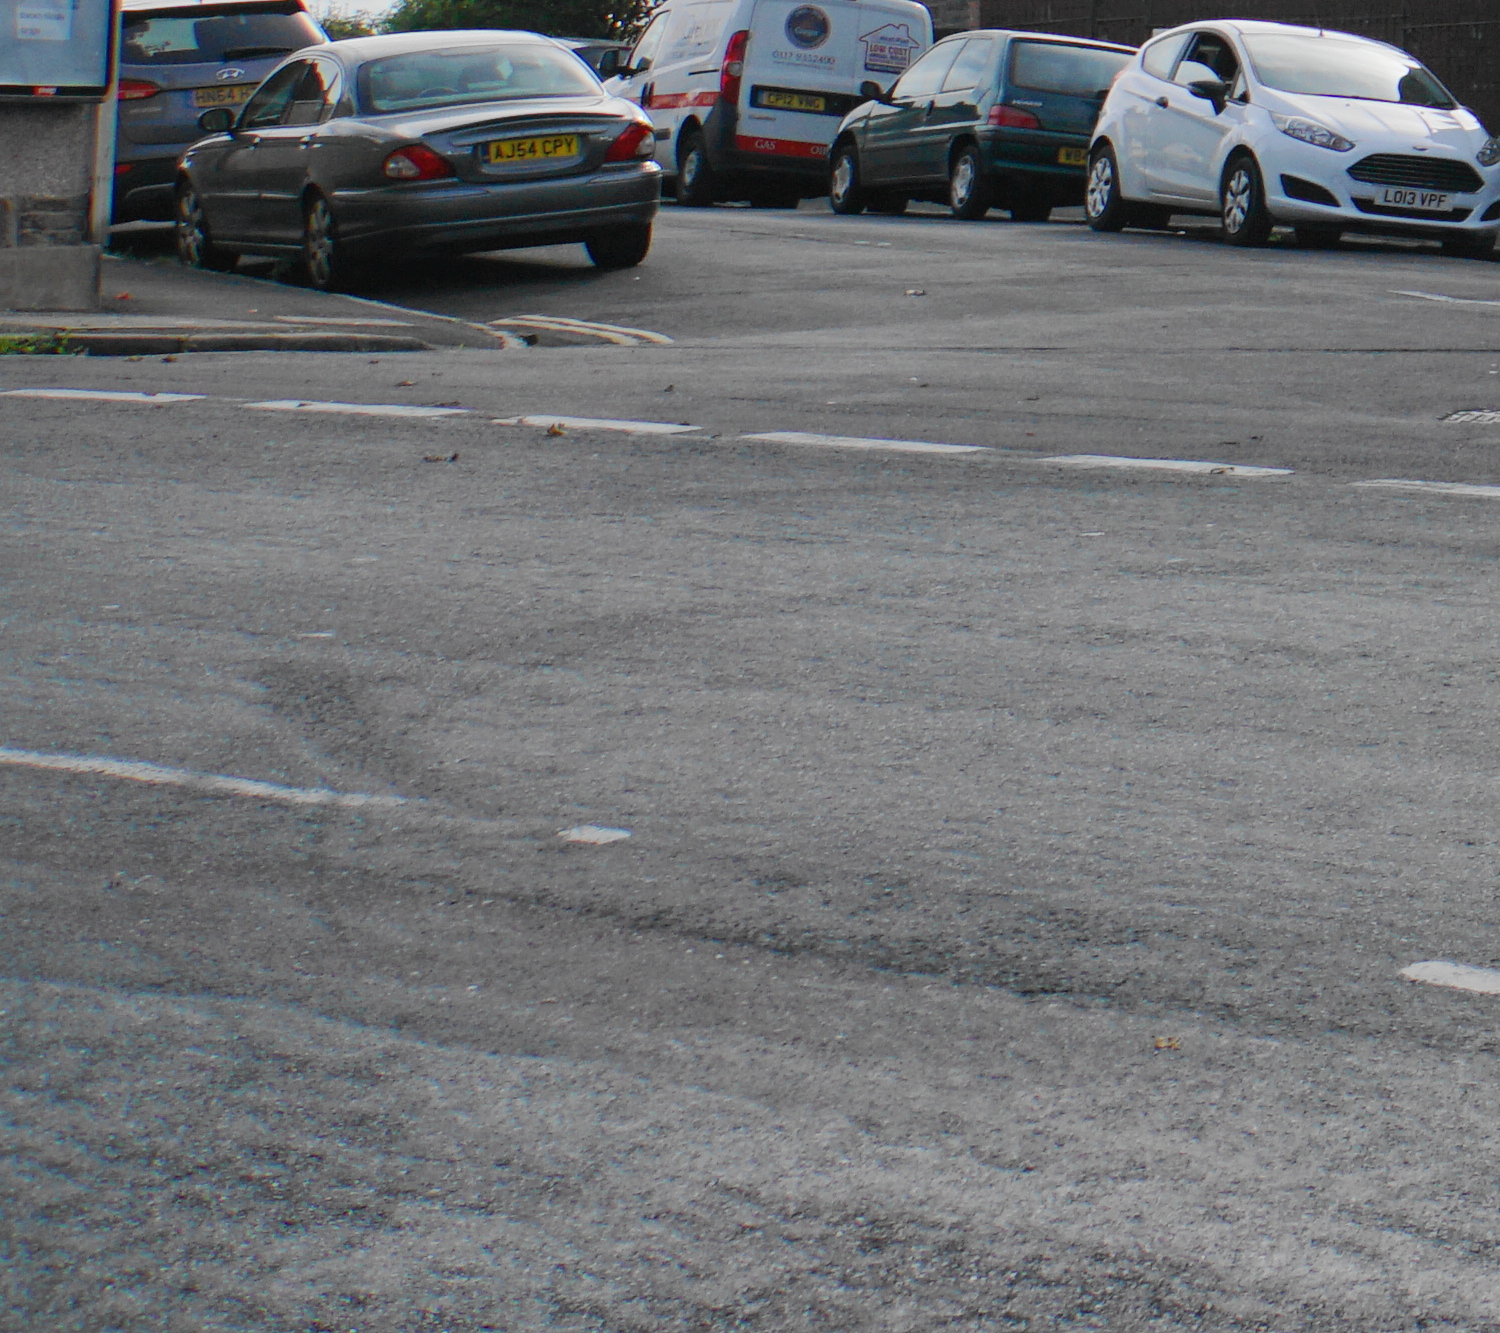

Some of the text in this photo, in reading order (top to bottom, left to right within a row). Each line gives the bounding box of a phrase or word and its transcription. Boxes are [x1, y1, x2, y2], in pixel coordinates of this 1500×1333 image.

[870, 44, 907, 56] LOW COST
[494, 138, 574, 159] AJ54 CPY
[755, 139, 776, 149] GAS
[1384, 189, 1447, 207] LO13 VPF
